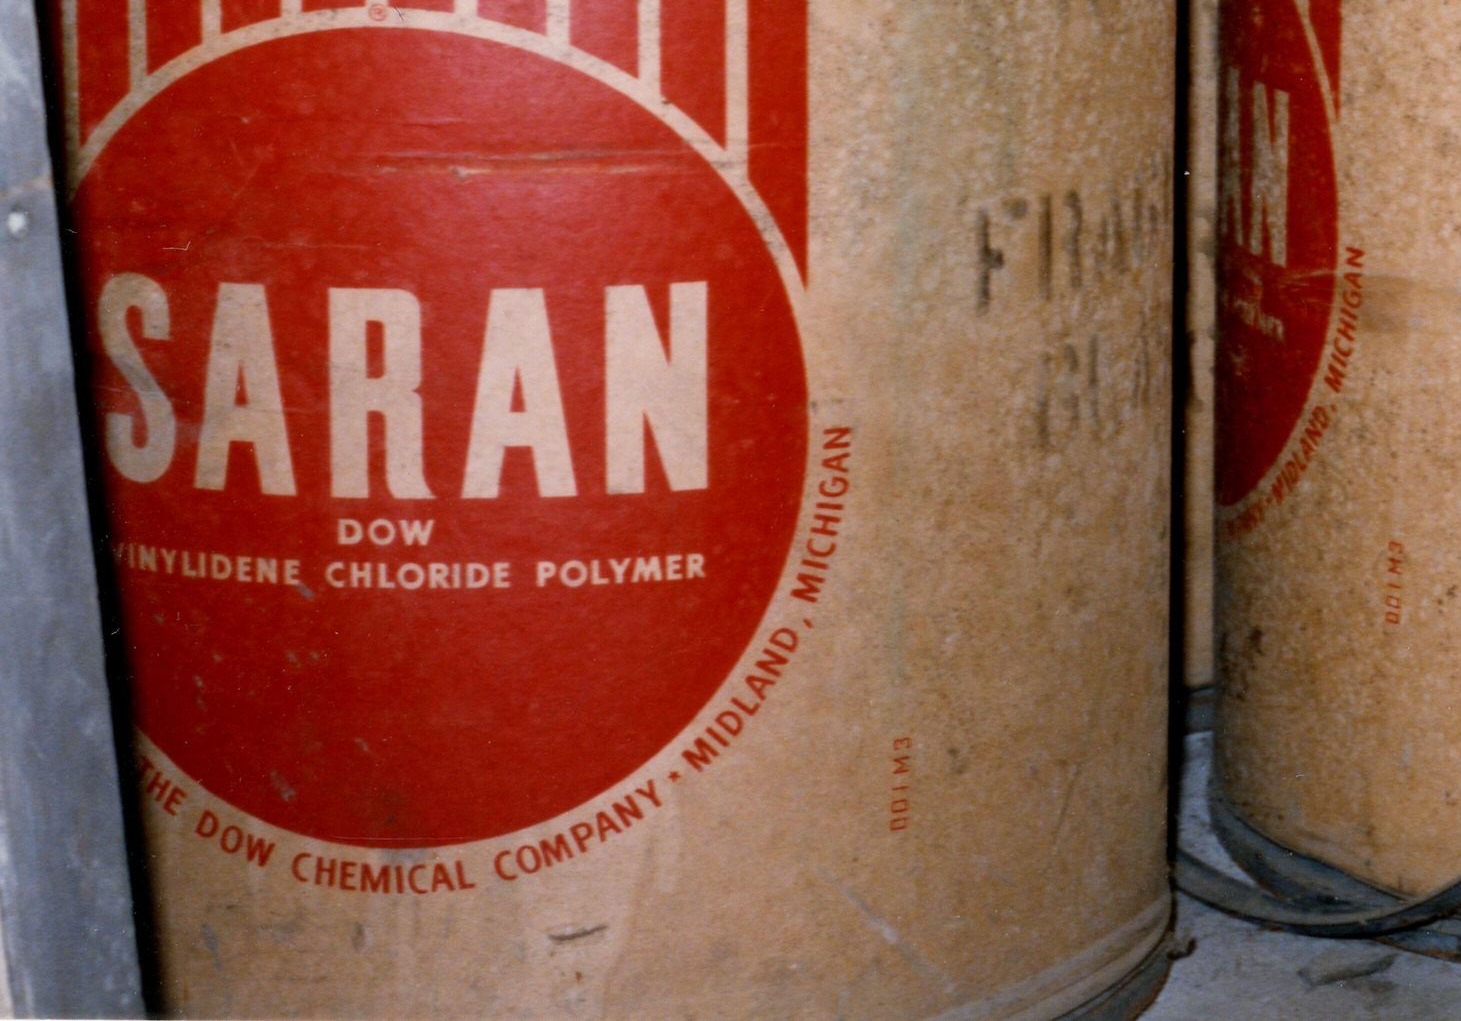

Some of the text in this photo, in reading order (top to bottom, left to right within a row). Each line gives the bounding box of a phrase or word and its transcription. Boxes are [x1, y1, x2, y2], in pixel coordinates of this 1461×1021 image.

[98, 271, 709, 500] SARAN
[1323, 245, 1367, 394] MICHIGAN
[324, 561, 512, 590] CHLORIDE
[536, 552, 706, 586] POLYMER
[336, 518, 435, 547] DOW
[140, 756, 188, 817] THE
[195, 809, 277, 868] DOW
[291, 852, 475, 895] CHEMICAL
[493, 779, 662, 882] COMPANY
[789, 426, 852, 604] MICHIGAN
